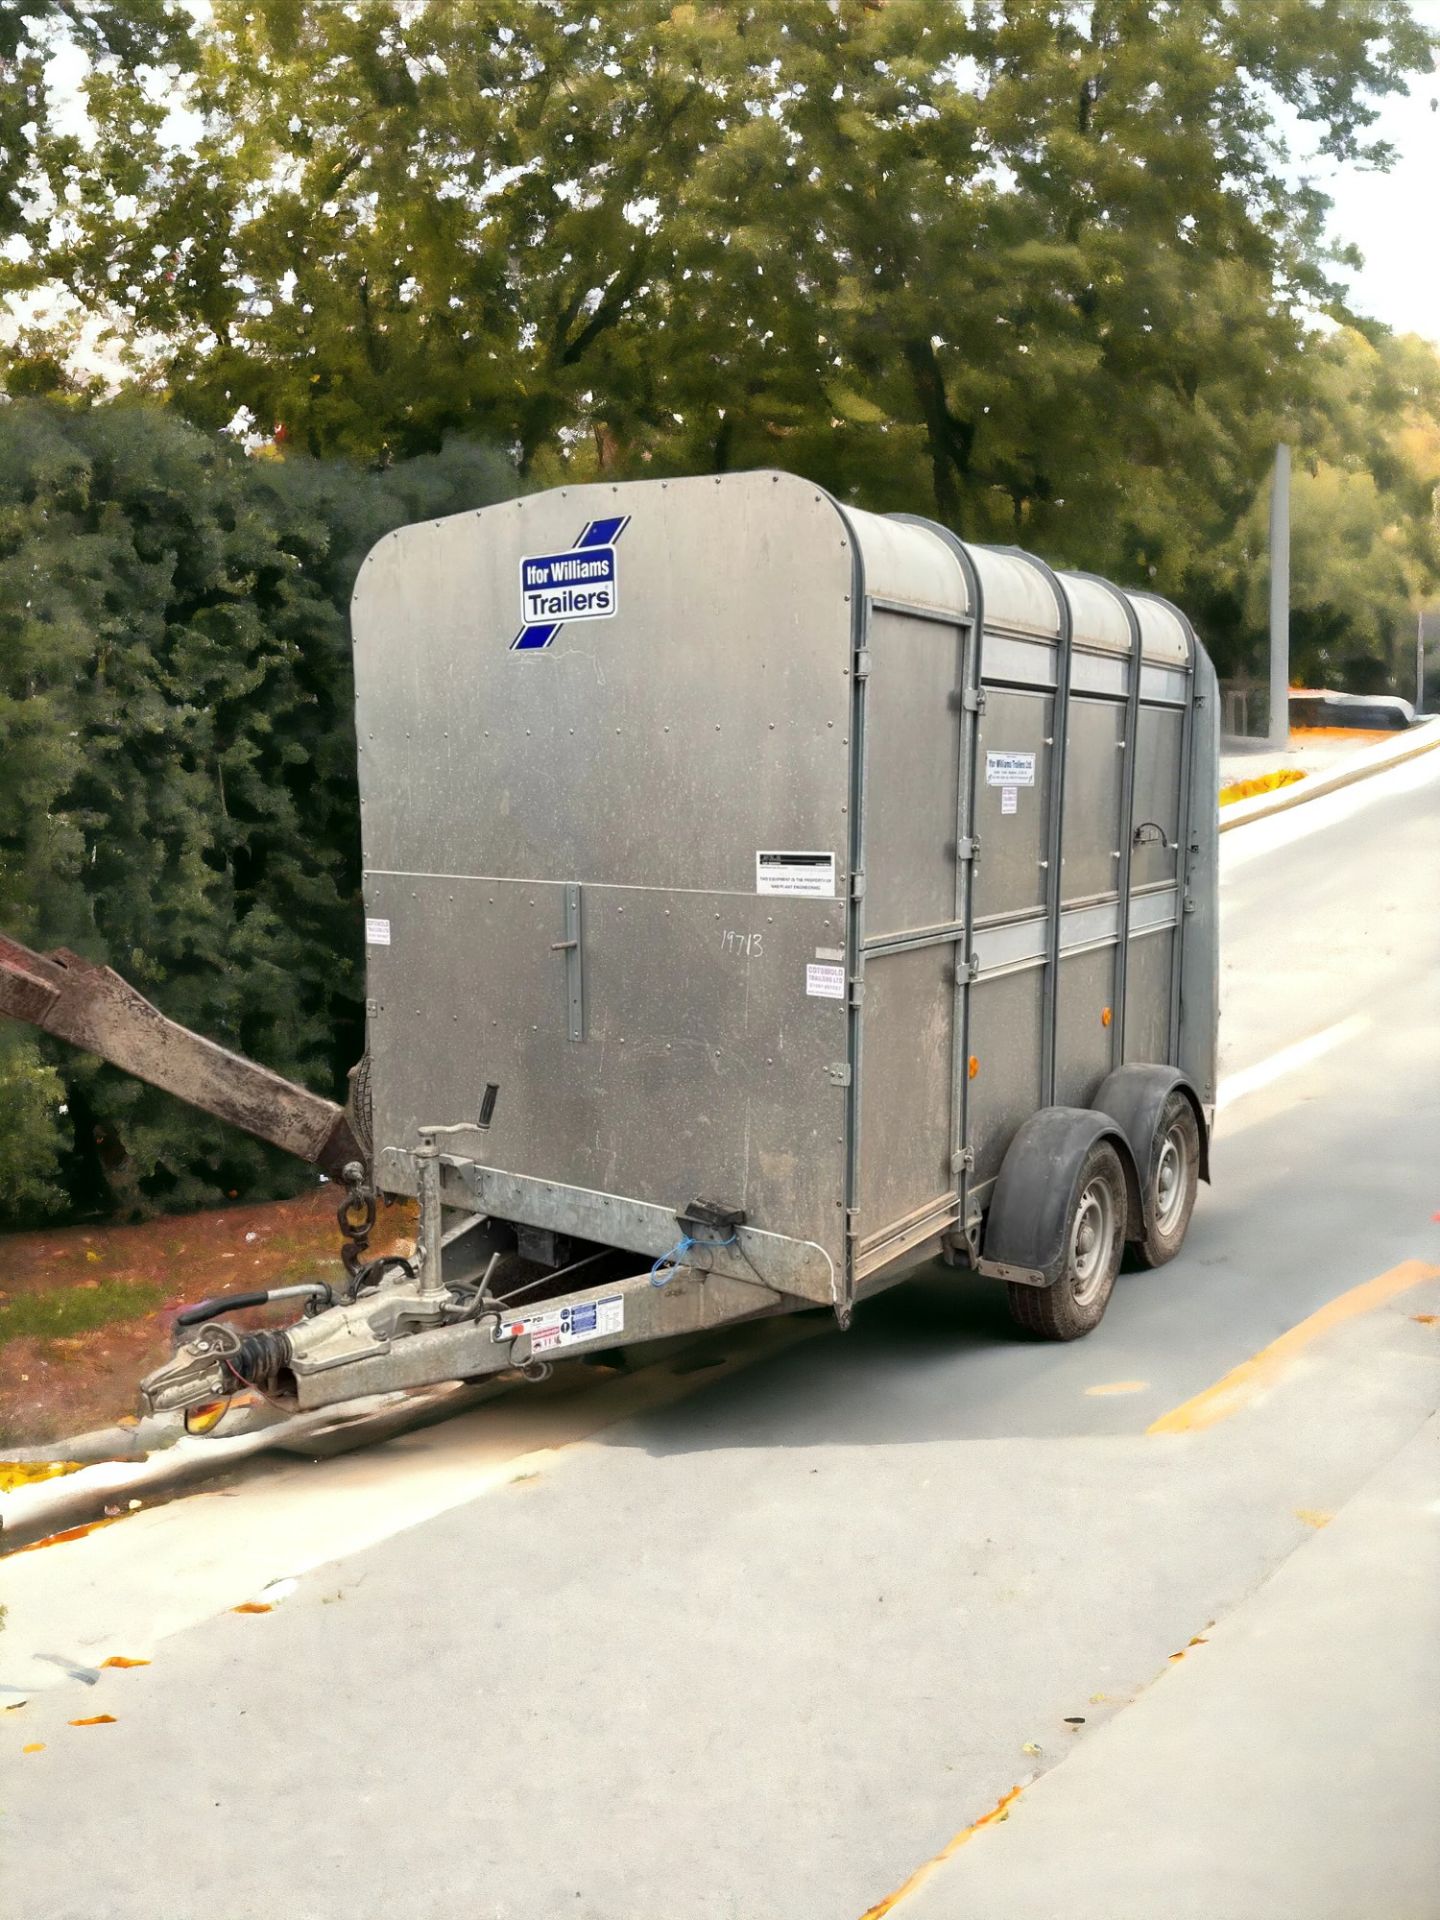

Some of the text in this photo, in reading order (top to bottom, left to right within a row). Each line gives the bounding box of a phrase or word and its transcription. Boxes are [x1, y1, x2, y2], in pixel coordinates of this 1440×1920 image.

[527, 560, 609, 585] Ifor Williams
[528, 590, 610, 615] Trailers
[721, 930, 763, 957] 19713
